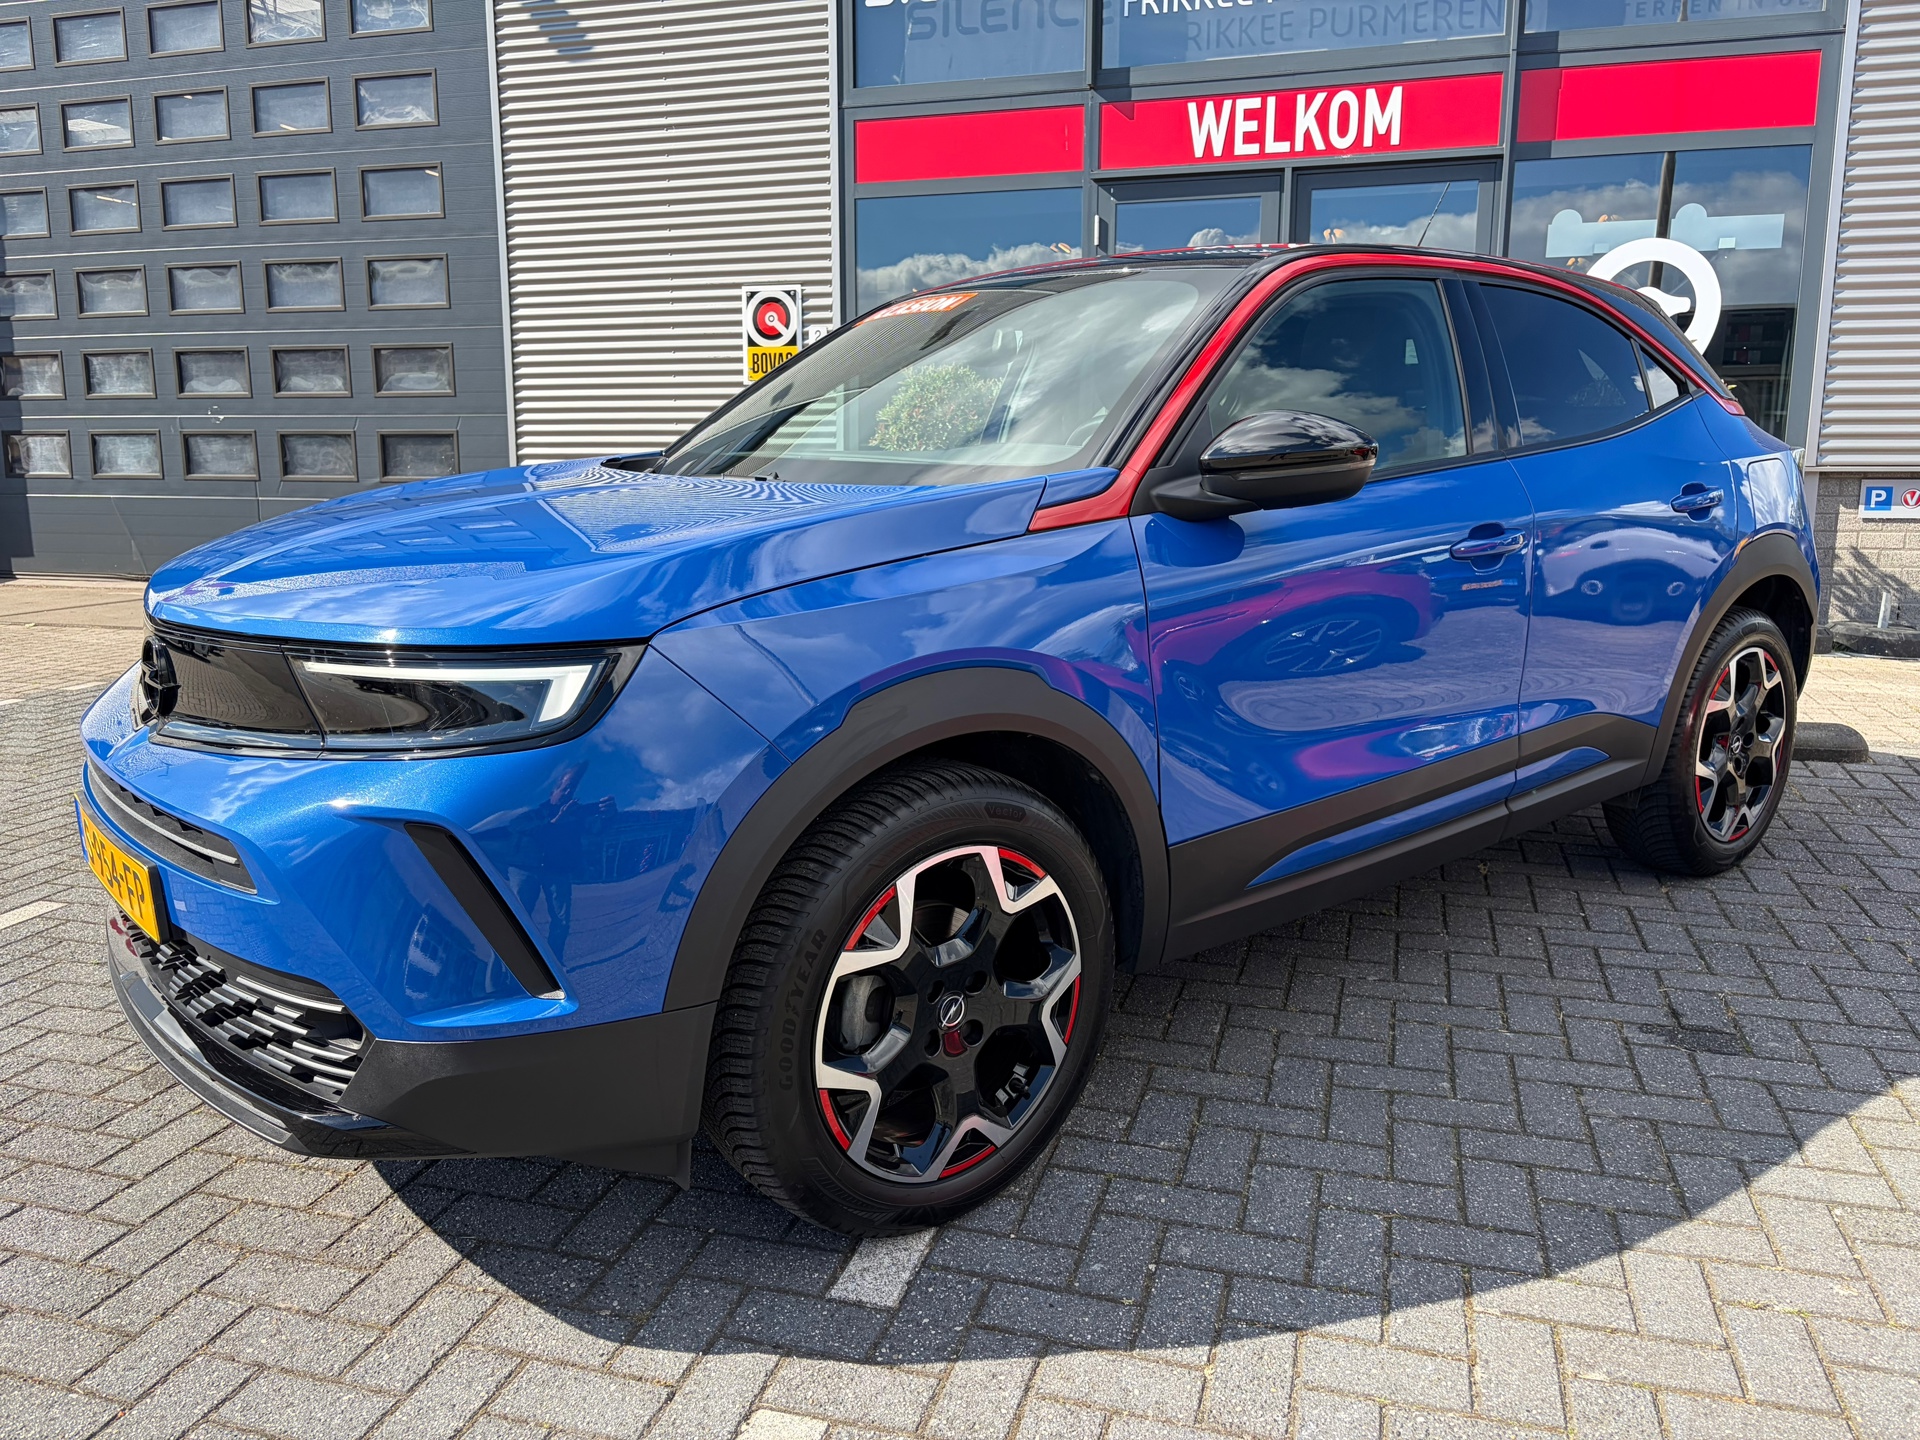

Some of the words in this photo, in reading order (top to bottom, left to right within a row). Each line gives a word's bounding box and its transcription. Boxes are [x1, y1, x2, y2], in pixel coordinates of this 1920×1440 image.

[1187, 86, 1403, 158] WELKOM
[1870, 489, 1887, 508] P
[779, 928, 828, 1091] GOODYEAR
